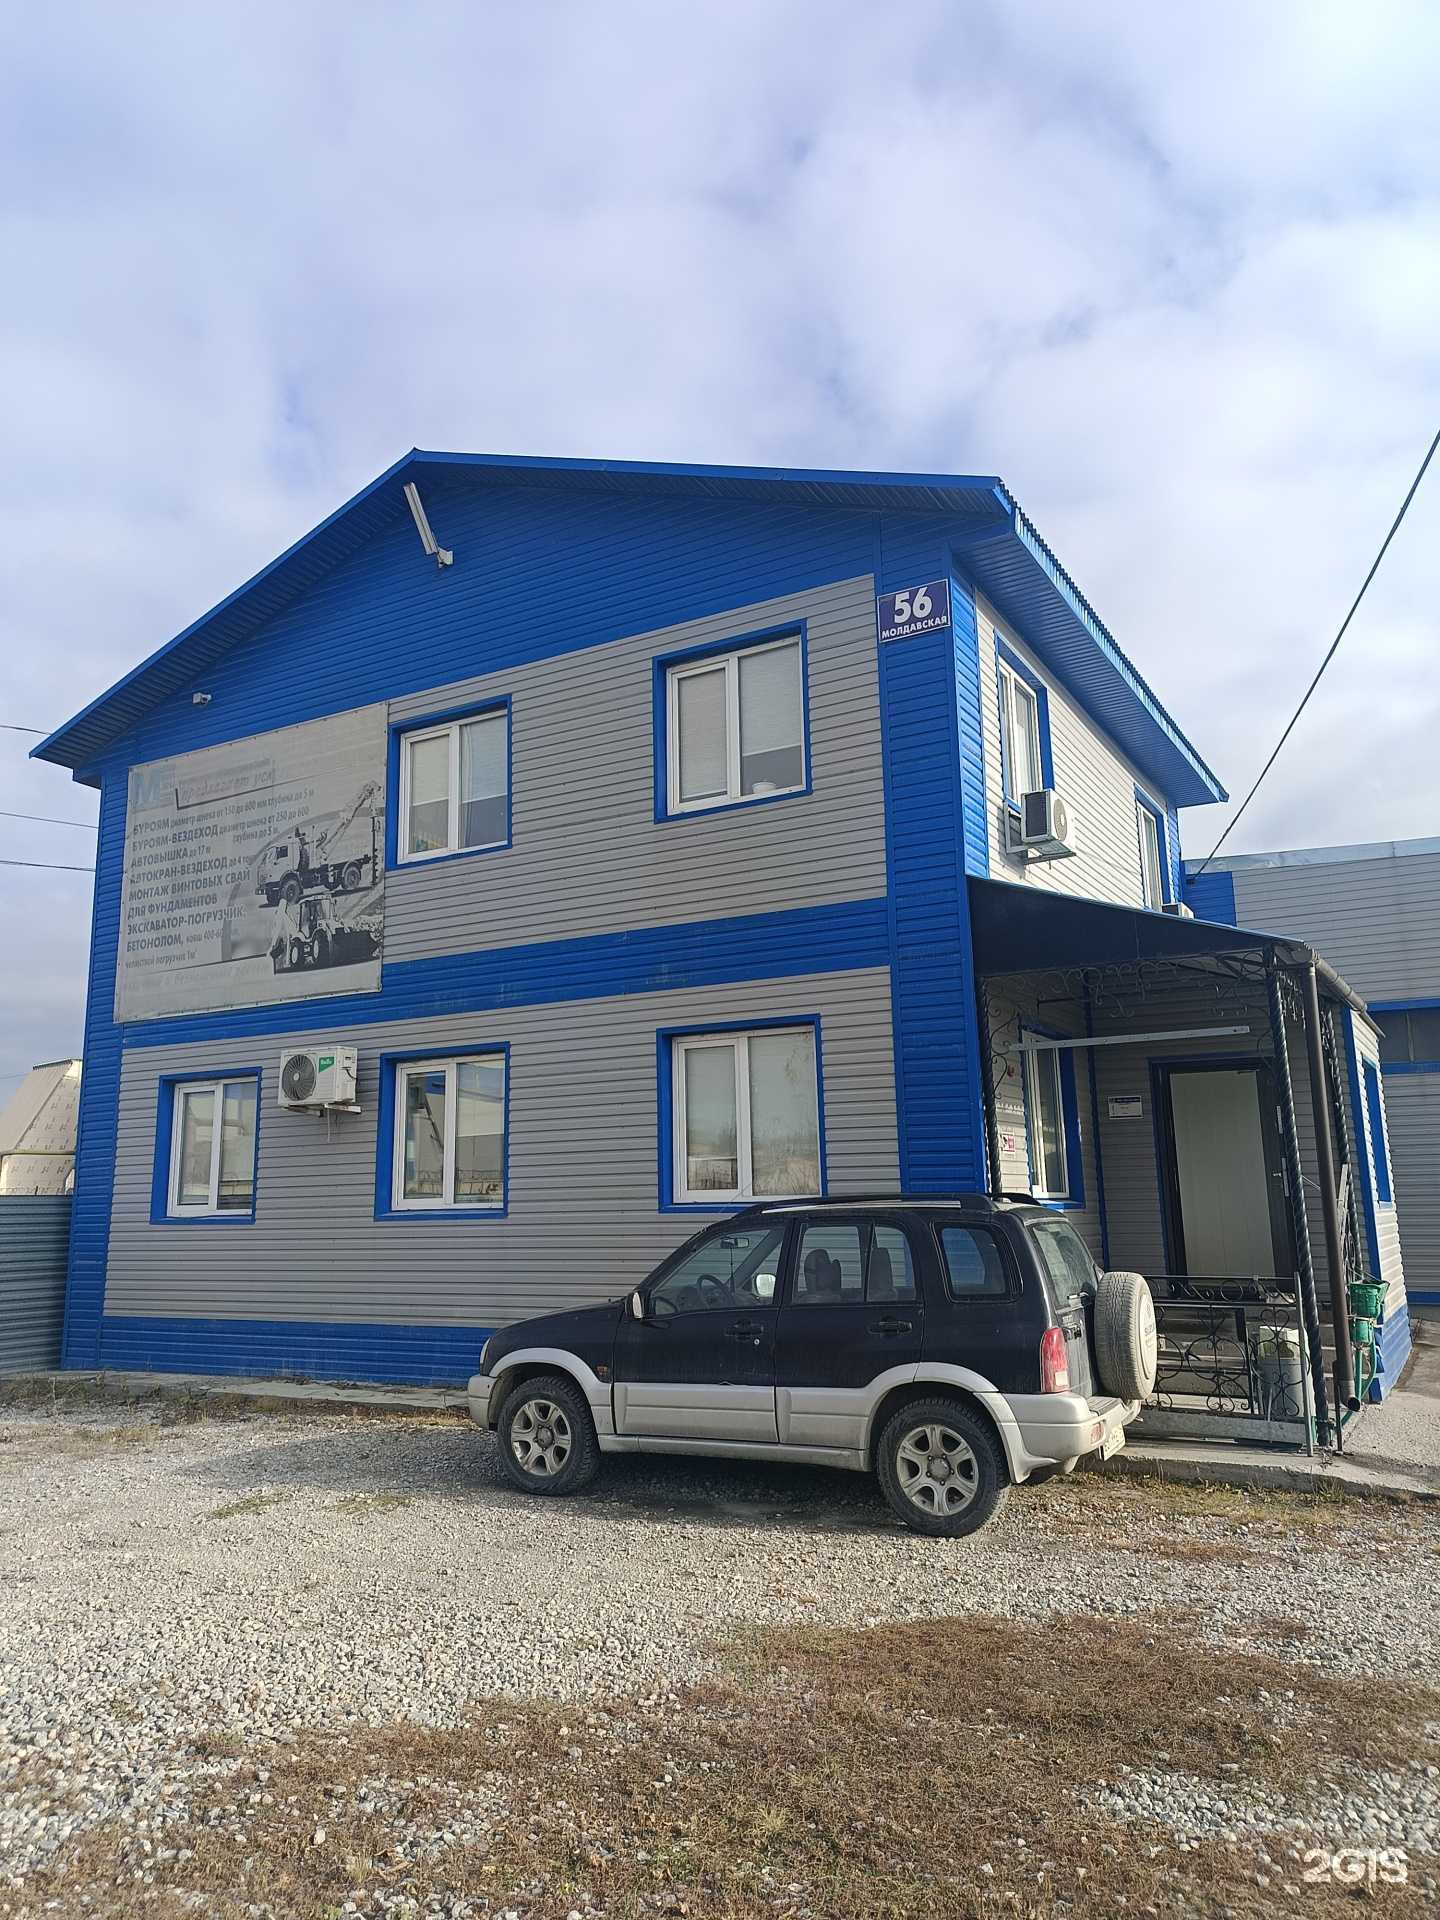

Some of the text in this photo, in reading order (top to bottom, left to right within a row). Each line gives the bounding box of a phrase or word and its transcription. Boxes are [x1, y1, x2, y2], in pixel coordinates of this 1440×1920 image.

[894, 586, 932, 624] 56
[881, 615, 947, 639] МОЛДАВСКАЯ
[132, 824, 218, 852] БУРОЯМ-ВЕЗДЕХОД
[133, 818, 169, 835] БУРОЯМ
[130, 856, 227, 884] АВТОКРАН-ВЕЗДЕХОД
[131, 847, 188, 868] АВТОВЫШКА
[129, 867, 250, 902] МОНТАЖ ВИНТОВЫХ СВАЙ
[127, 893, 218, 920] ДЛЯ ФУНДАМЕНТОВ
[126, 933, 183, 952] БЕТОНОЛОМ,
